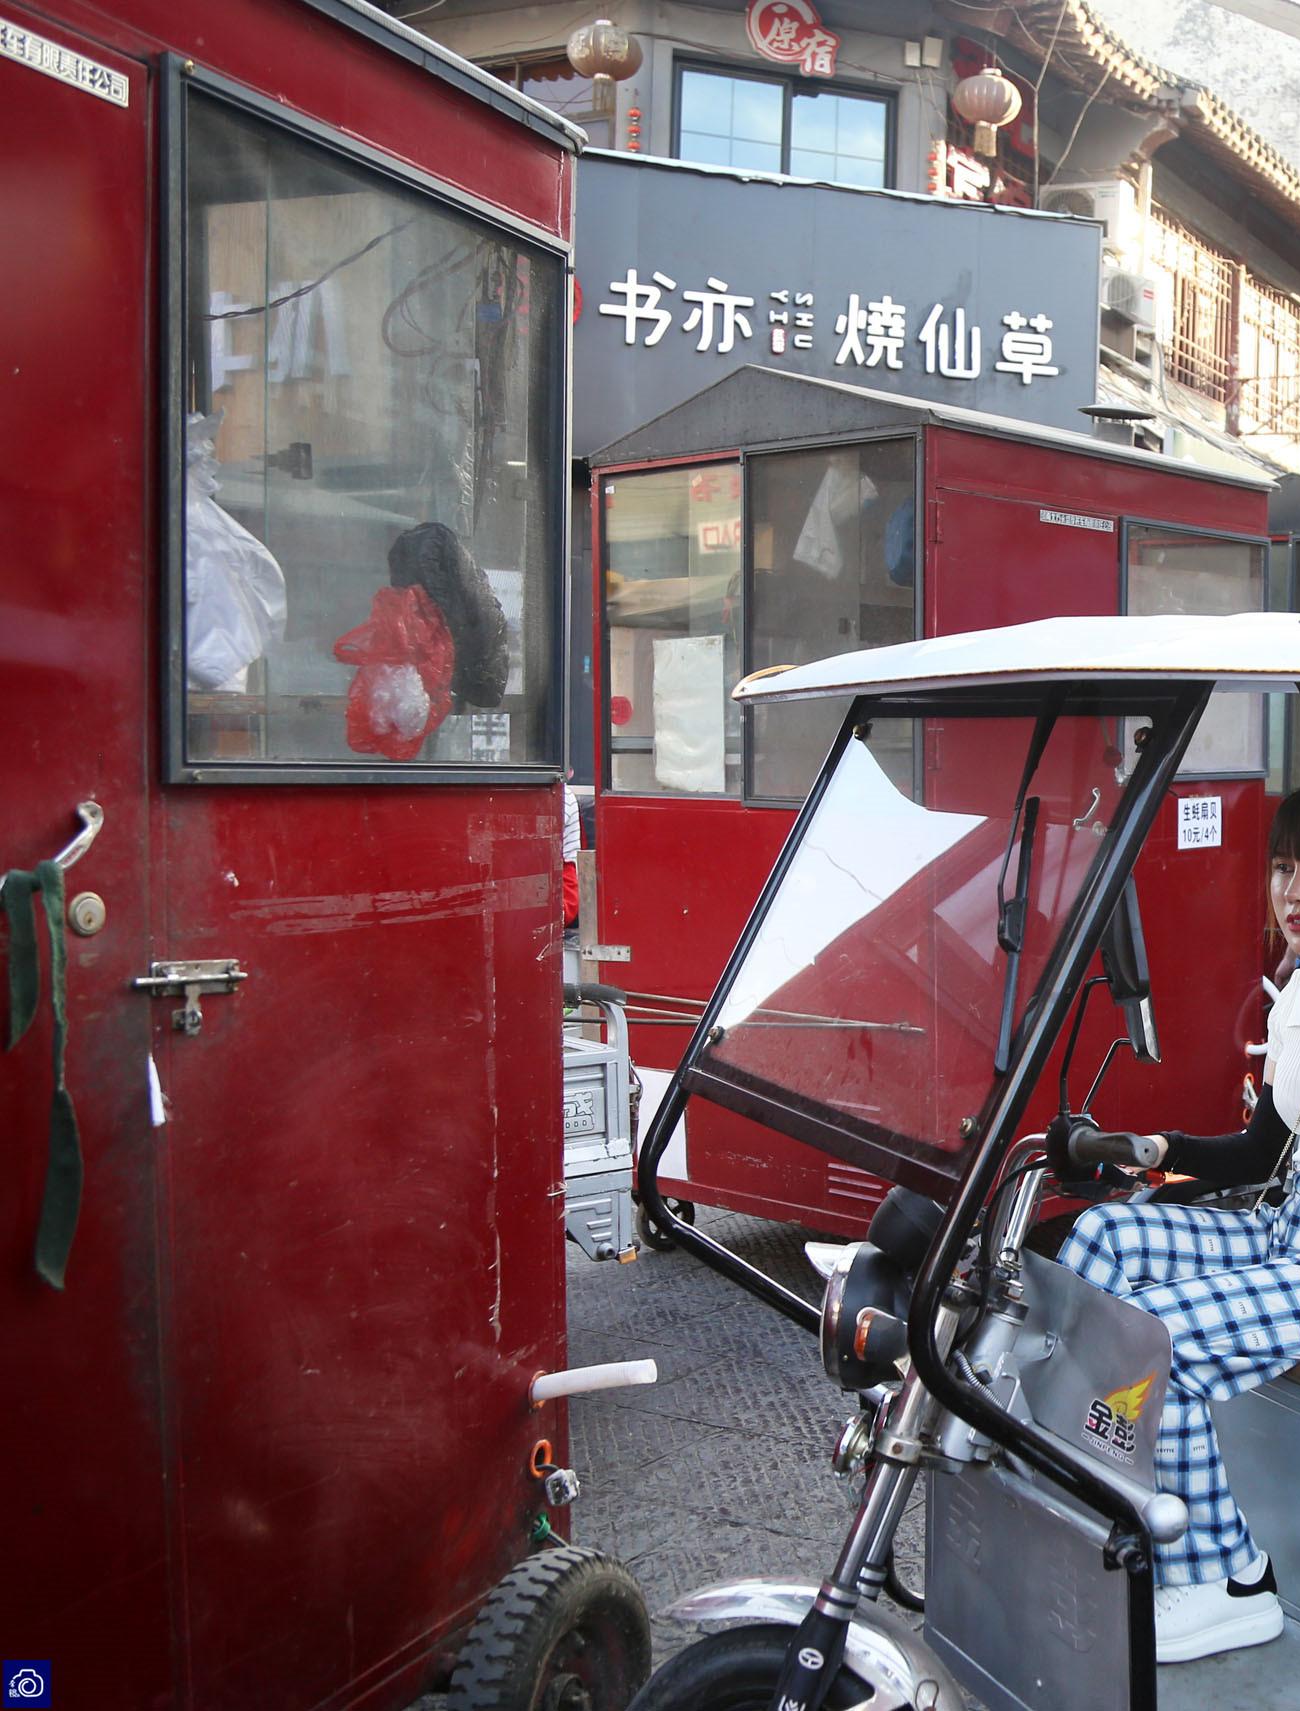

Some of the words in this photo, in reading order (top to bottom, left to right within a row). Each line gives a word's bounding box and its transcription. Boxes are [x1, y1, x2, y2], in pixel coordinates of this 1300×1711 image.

[599, 268, 754, 353] 书亦
[769, 289, 789, 325] YI
[793, 292, 814, 349] SHU
[1183, 801, 1217, 821] 生蚝扇贝
[1183, 825, 1217, 843] 10元/4个
[1084, 1399, 1135, 1453] 金彭
